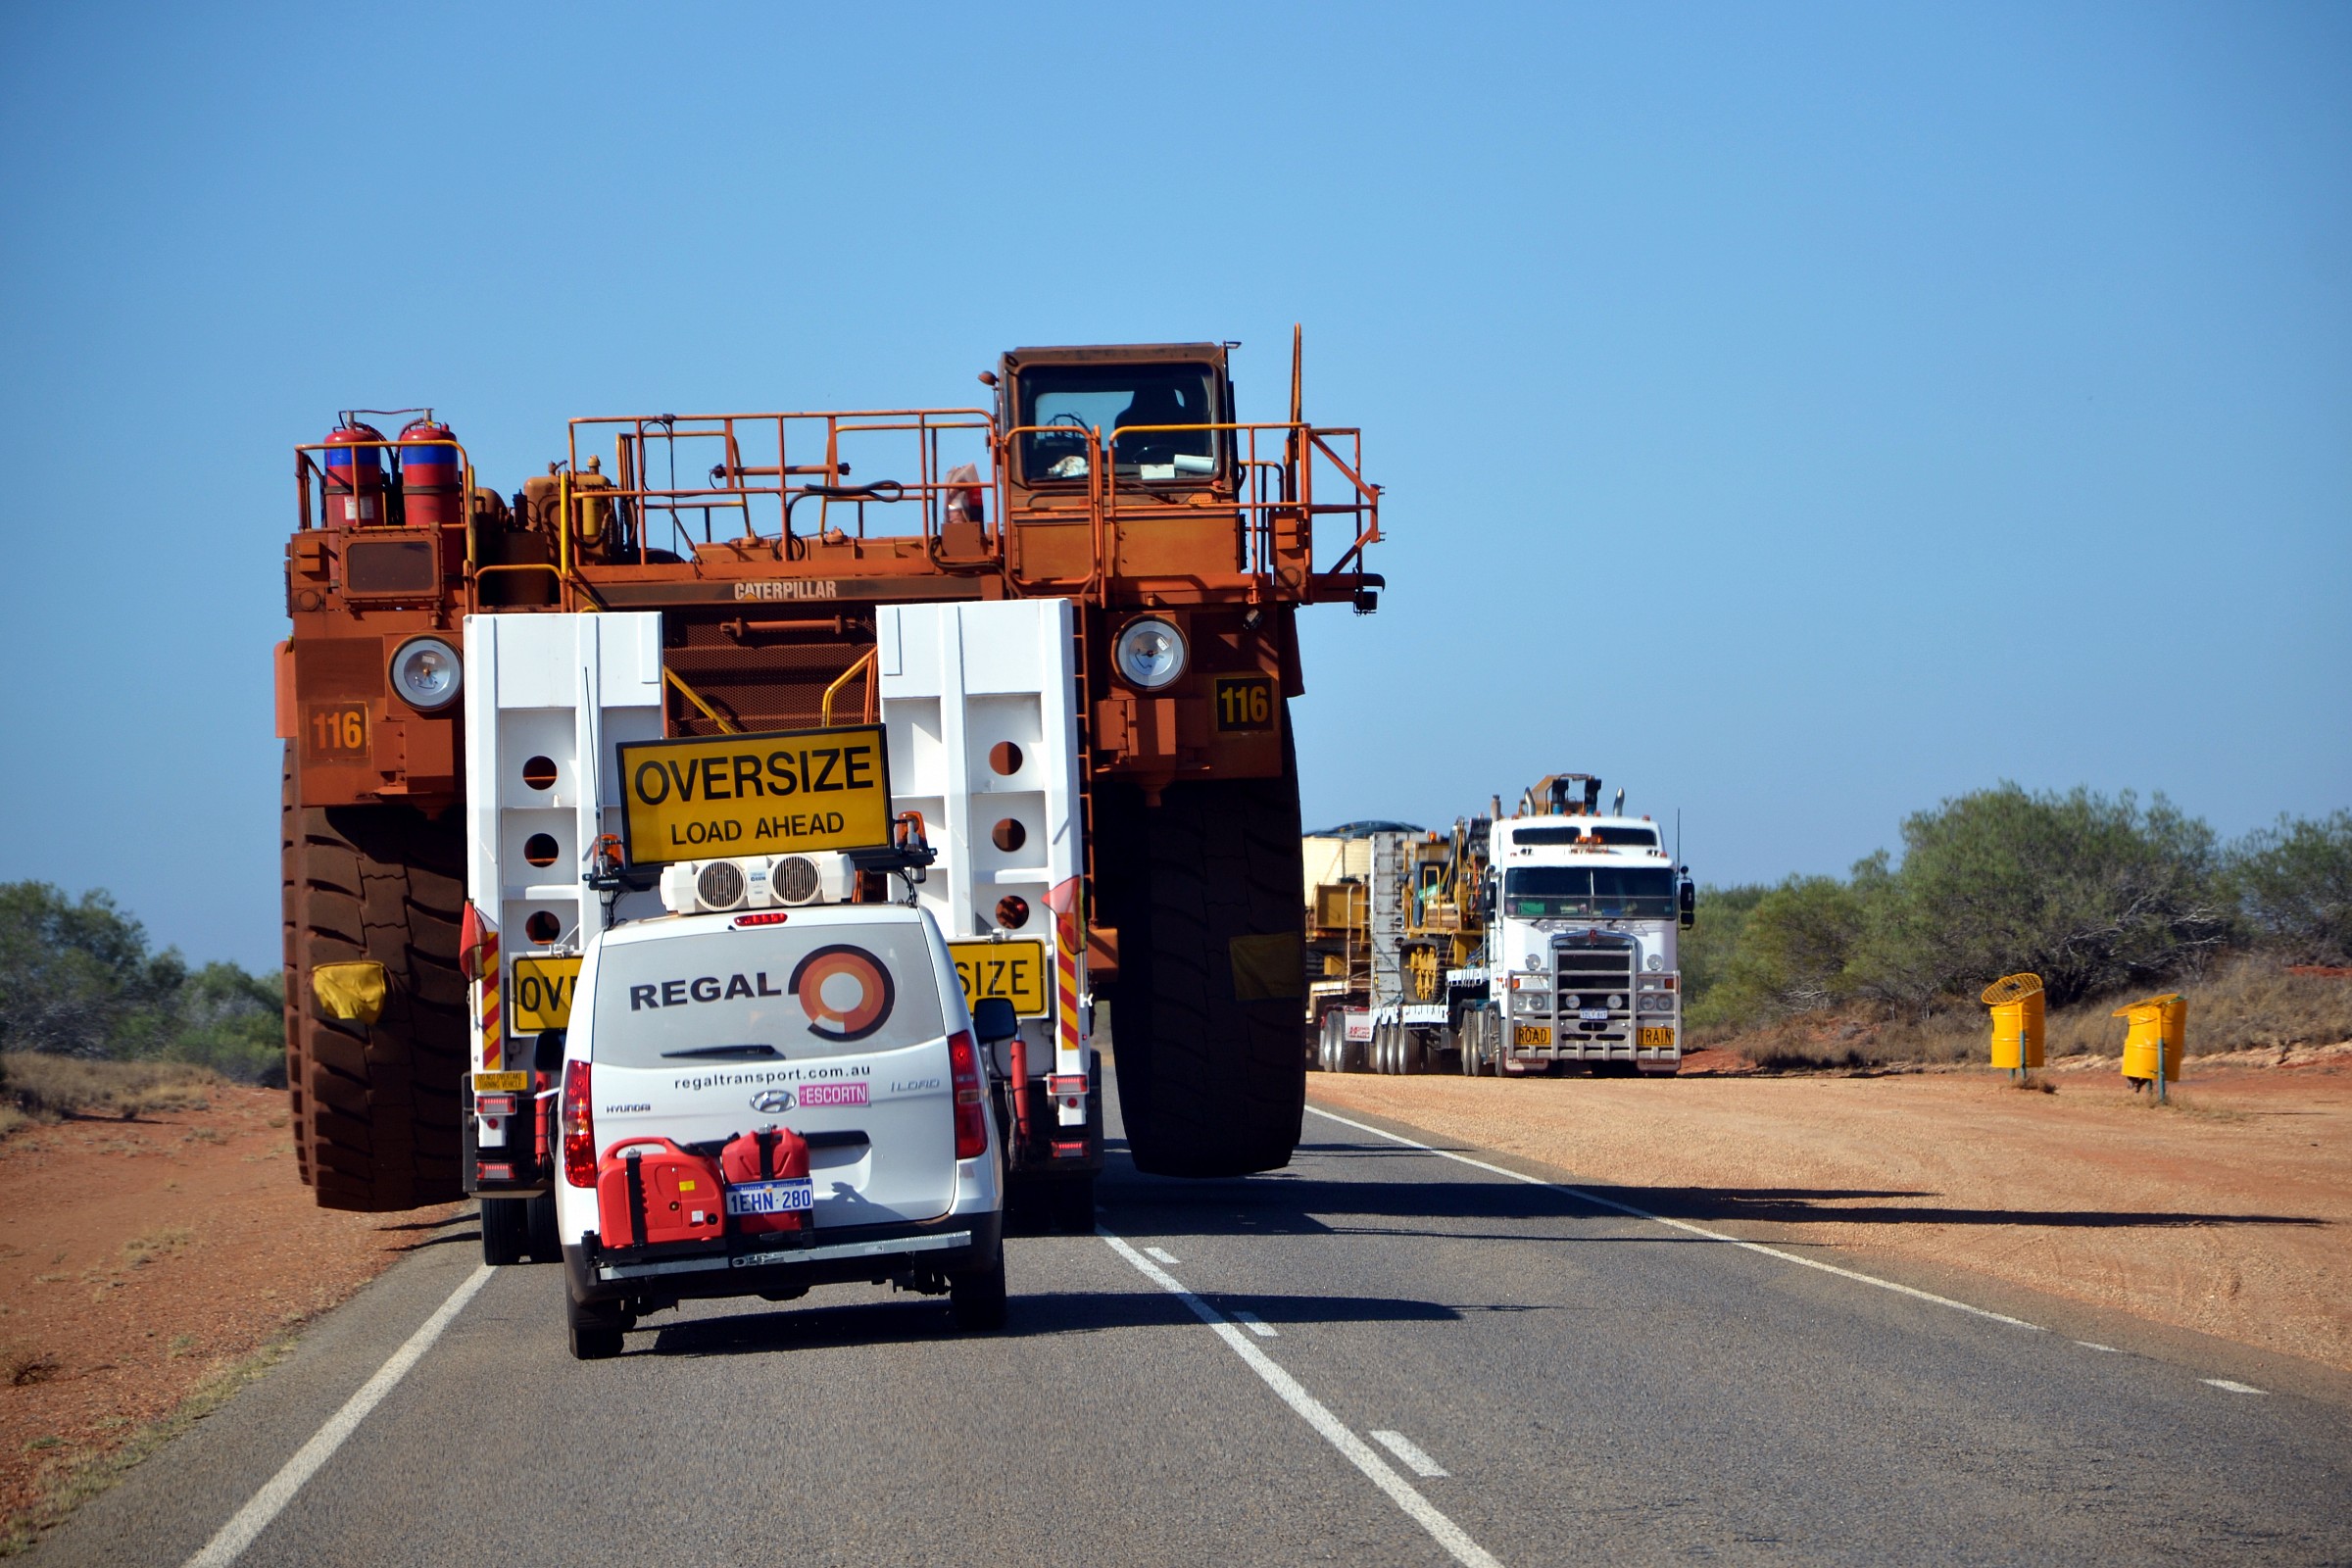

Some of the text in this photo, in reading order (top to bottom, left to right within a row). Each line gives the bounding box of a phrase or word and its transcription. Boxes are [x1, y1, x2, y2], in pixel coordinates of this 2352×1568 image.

[734, 580, 837, 601] CATERPILLAR
[1221, 686, 1268, 723] 116
[314, 711, 362, 750] 116
[635, 746, 874, 806] OVERSIZE
[671, 811, 845, 845] LOAD AHEAD
[630, 972, 782, 1011] REGAL
[1519, 1028, 1672, 1044] ROAD TRAIN
[674, 1065, 870, 1091] regaltransport.com.au
[607, 1104, 651, 1114] HYUNDAI
